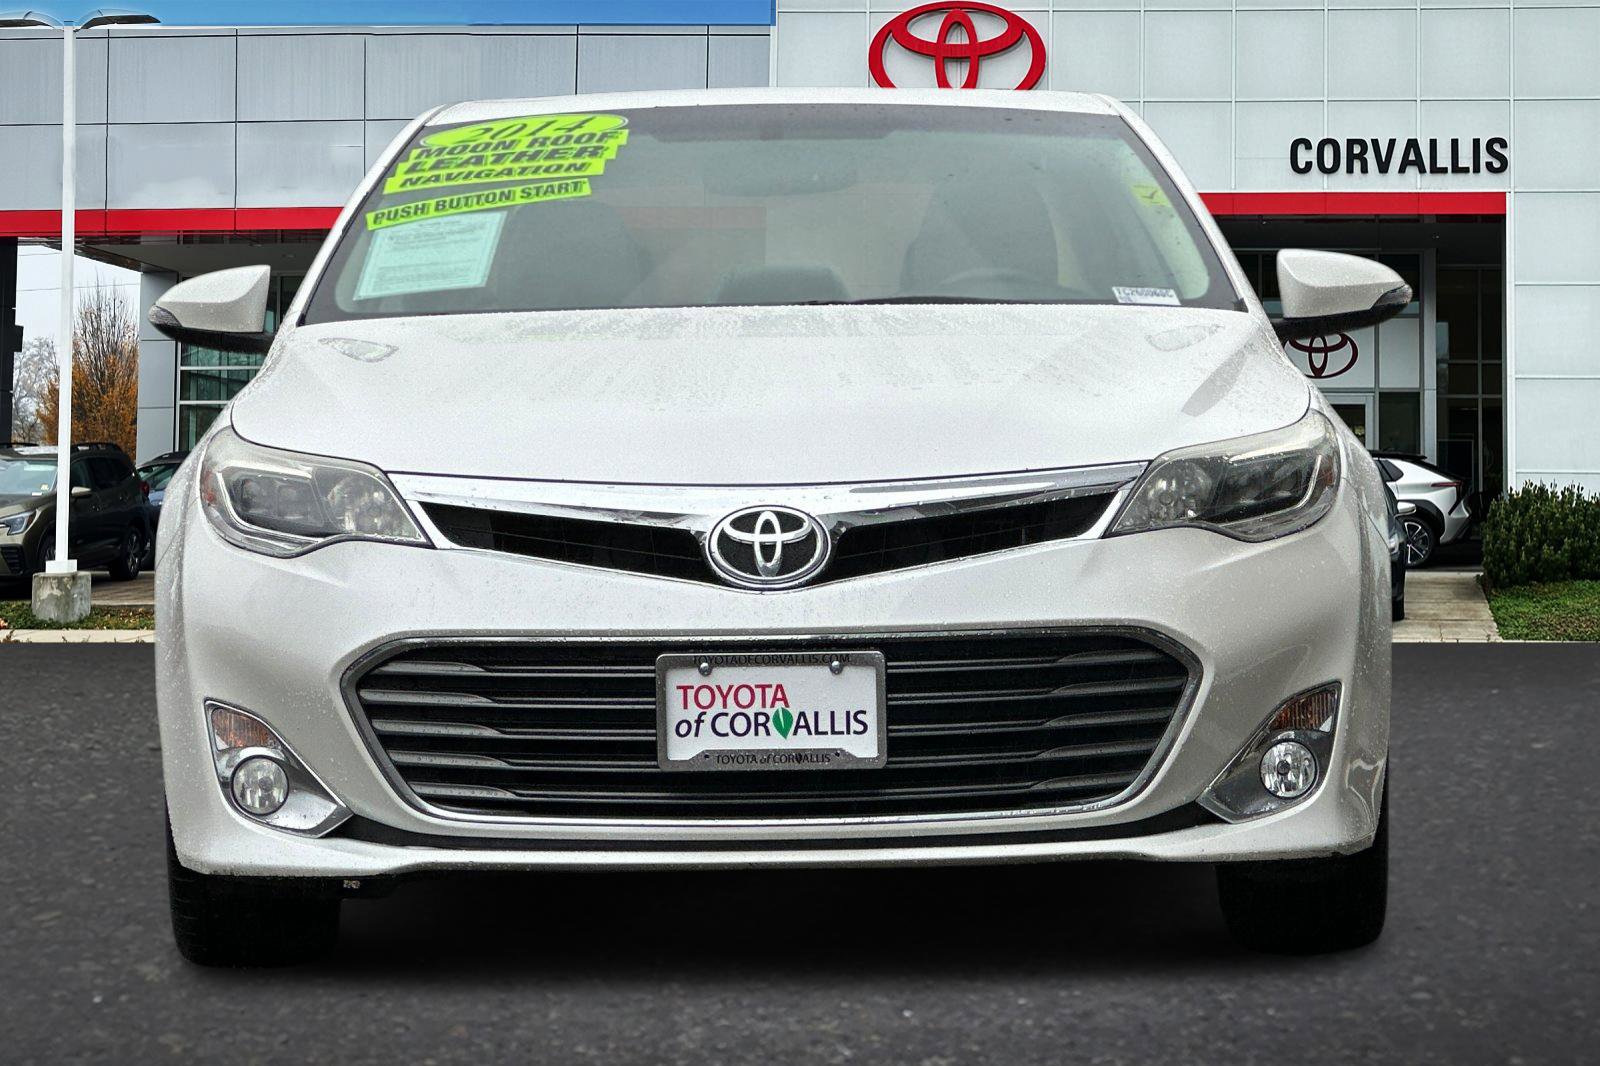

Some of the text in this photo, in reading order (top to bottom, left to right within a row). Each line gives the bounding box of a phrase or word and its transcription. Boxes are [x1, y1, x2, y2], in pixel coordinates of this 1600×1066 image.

[455, 116, 597, 144] 2014
[415, 130, 619, 159] MOON ROOF
[1290, 137, 1508, 174] CORVALLIS
[403, 145, 606, 174] LEATHER
[400, 162, 591, 188] NAVIGATION
[373, 181, 582, 225] PUSH BUTTON START
[676, 684, 790, 709] TOYOTA
[675, 711, 707, 738] of
[716, 754, 758, 764] TOYOTA
